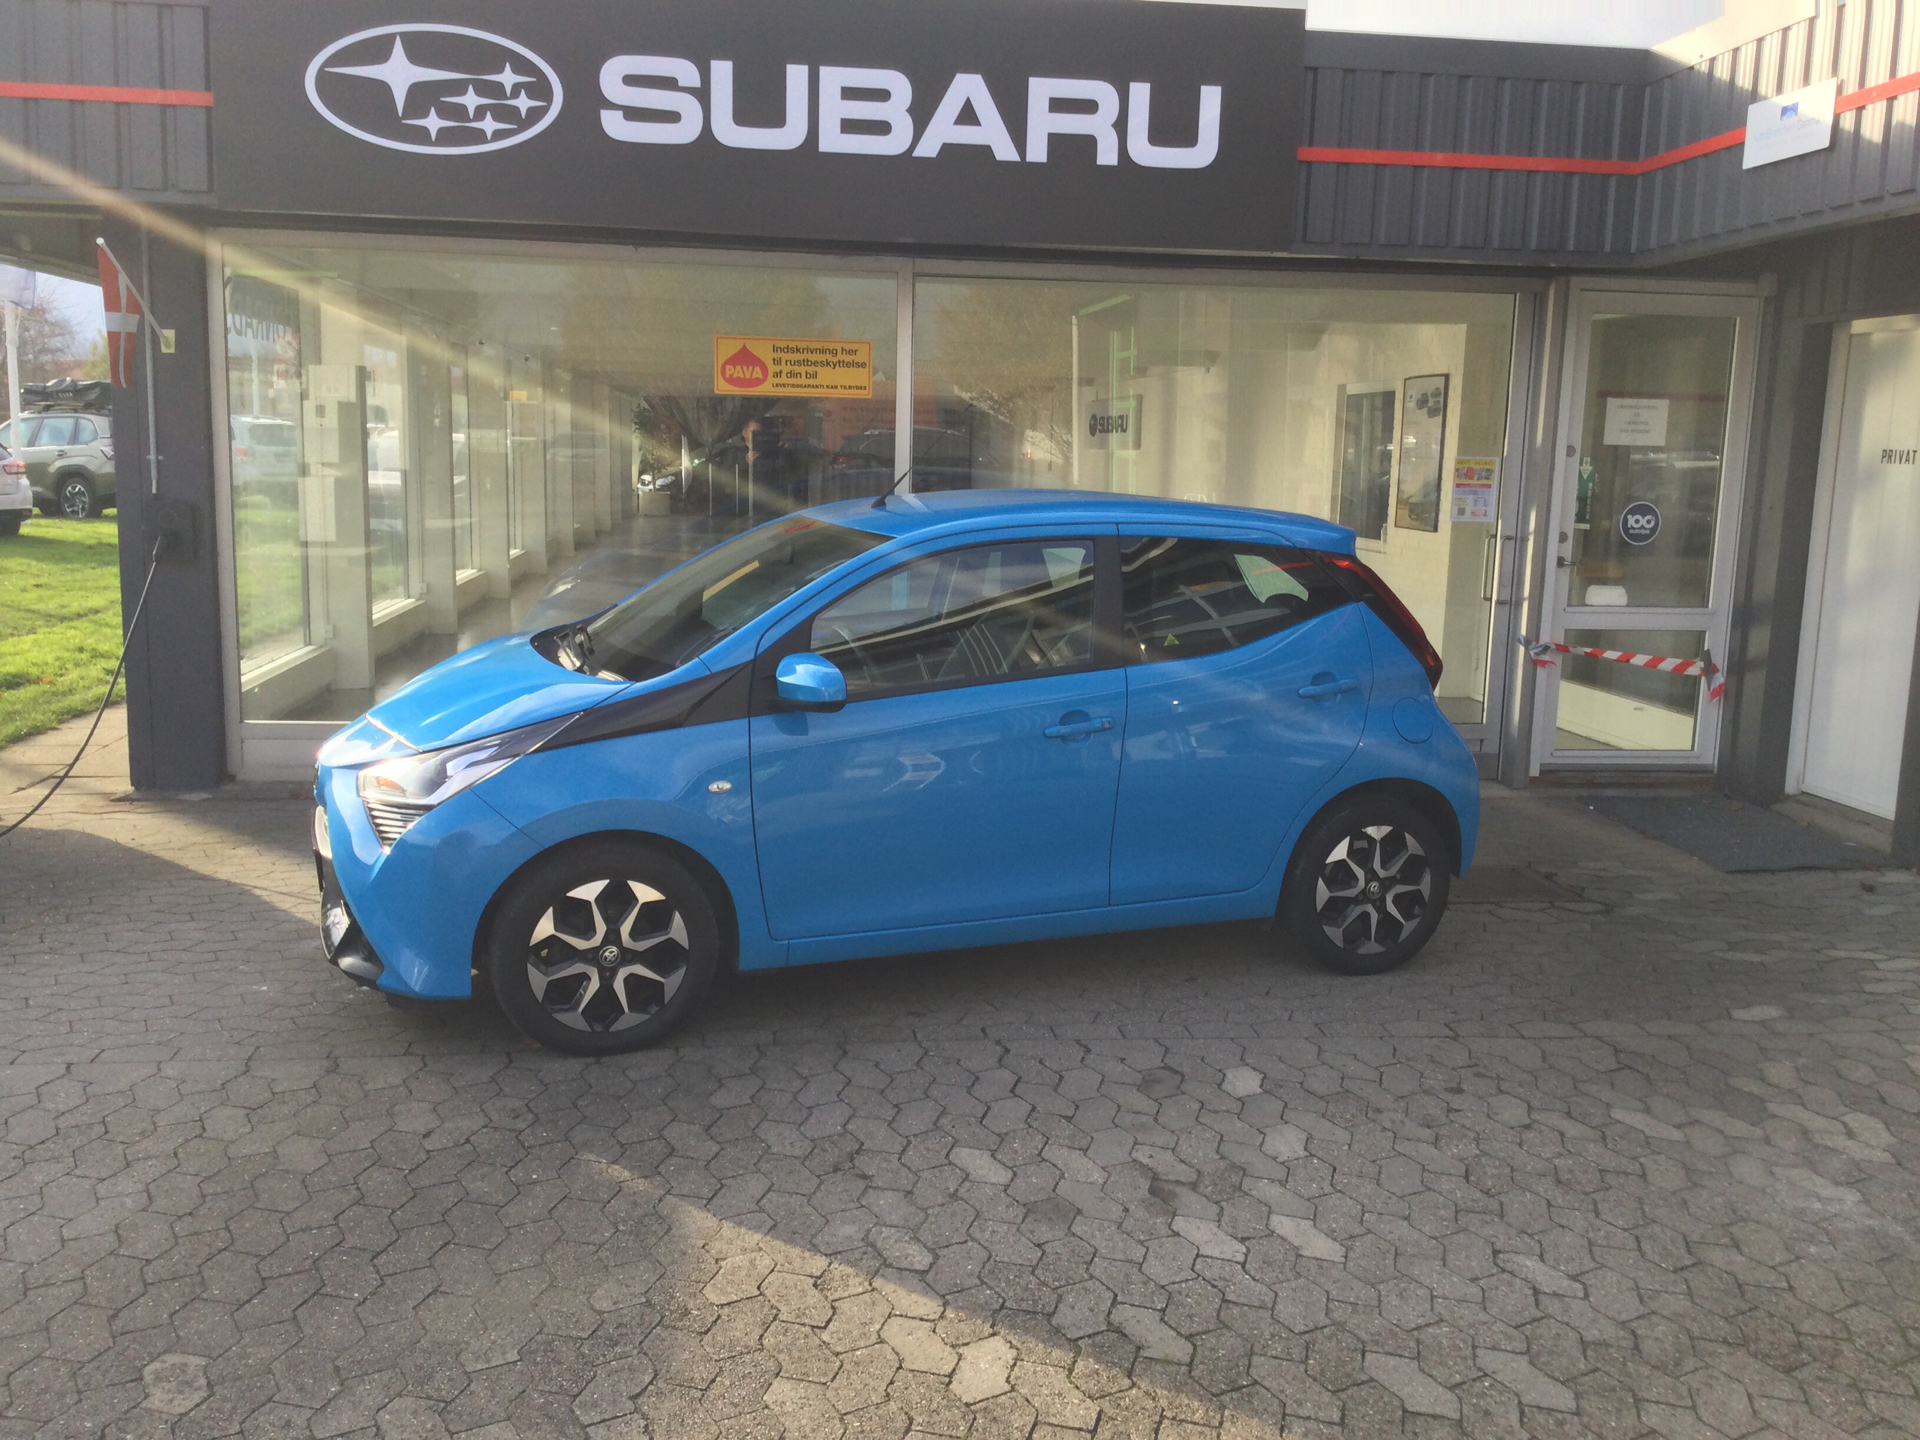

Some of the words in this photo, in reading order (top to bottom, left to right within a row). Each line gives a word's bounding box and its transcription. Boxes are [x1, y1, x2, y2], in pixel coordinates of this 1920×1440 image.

[599, 54, 1222, 169] SUBARU
[772, 344, 838, 357] Indskrivning
[841, 346, 858, 356] her
[772, 357, 782, 366] til
[785, 358, 867, 370] rustbeskyttelse
[725, 365, 763, 379] PAVA
[772, 369, 783, 379] af
[785, 370, 802, 379] din
[805, 370, 818, 380] bil
[1880, 449, 1918, 465] PRIVAT
[1626, 514, 1655, 529] 100
